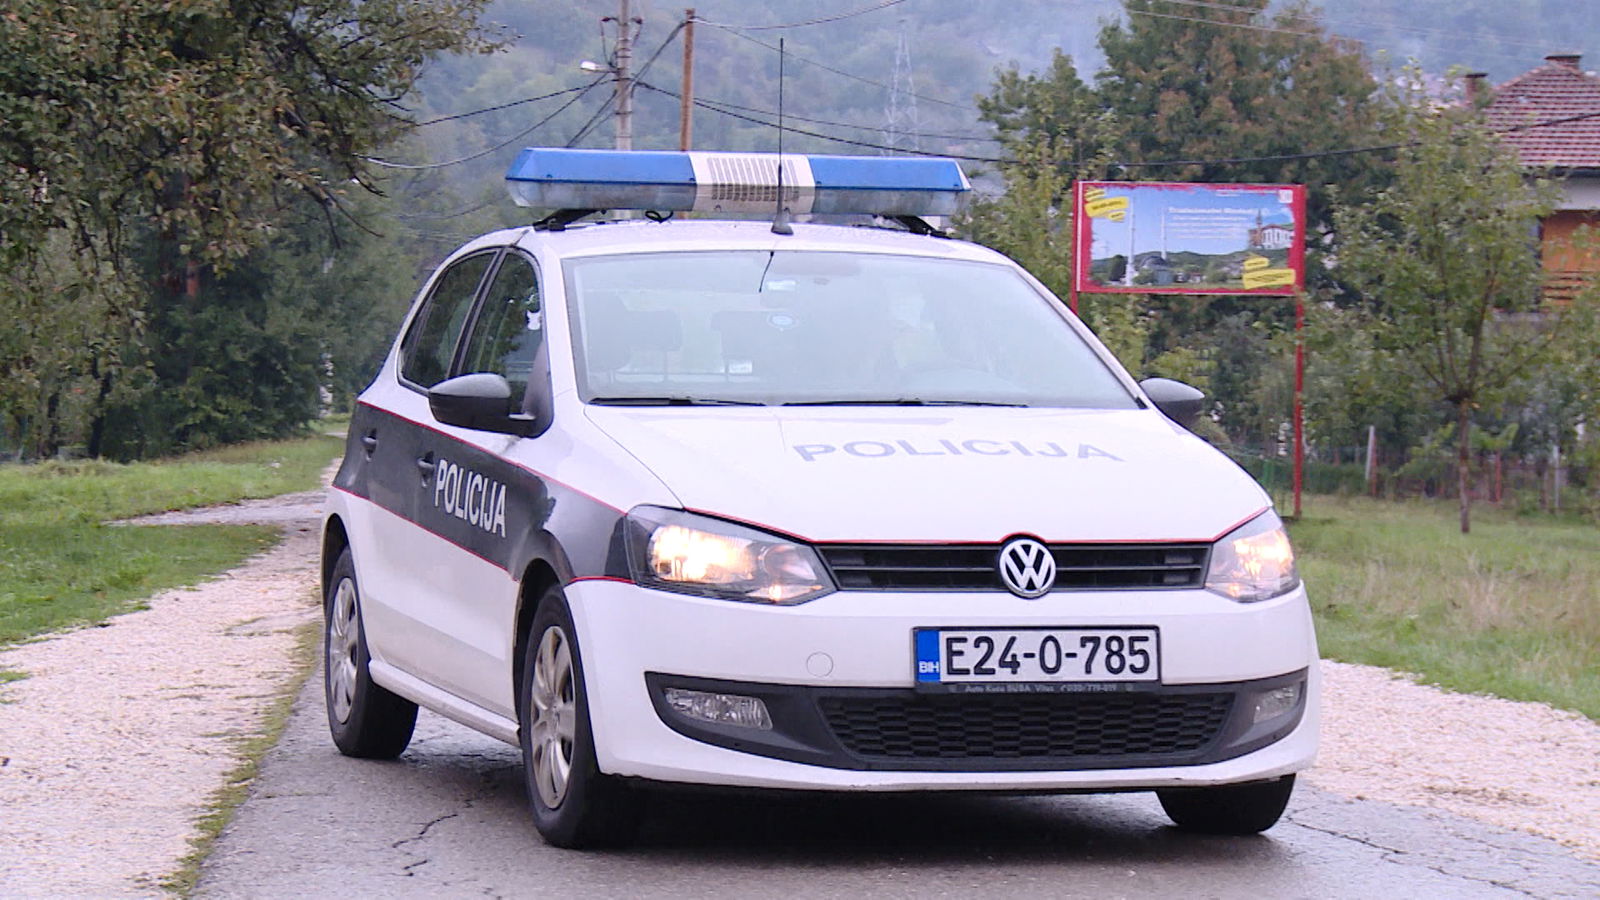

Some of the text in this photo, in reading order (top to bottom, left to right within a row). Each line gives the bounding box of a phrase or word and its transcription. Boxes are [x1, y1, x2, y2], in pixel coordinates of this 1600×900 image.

[793, 439, 1126, 462] POLICIJA
[434, 459, 507, 538] POLICIJA
[1000, 539, 1056, 596] VW
[919, 661, 940, 673] BIH
